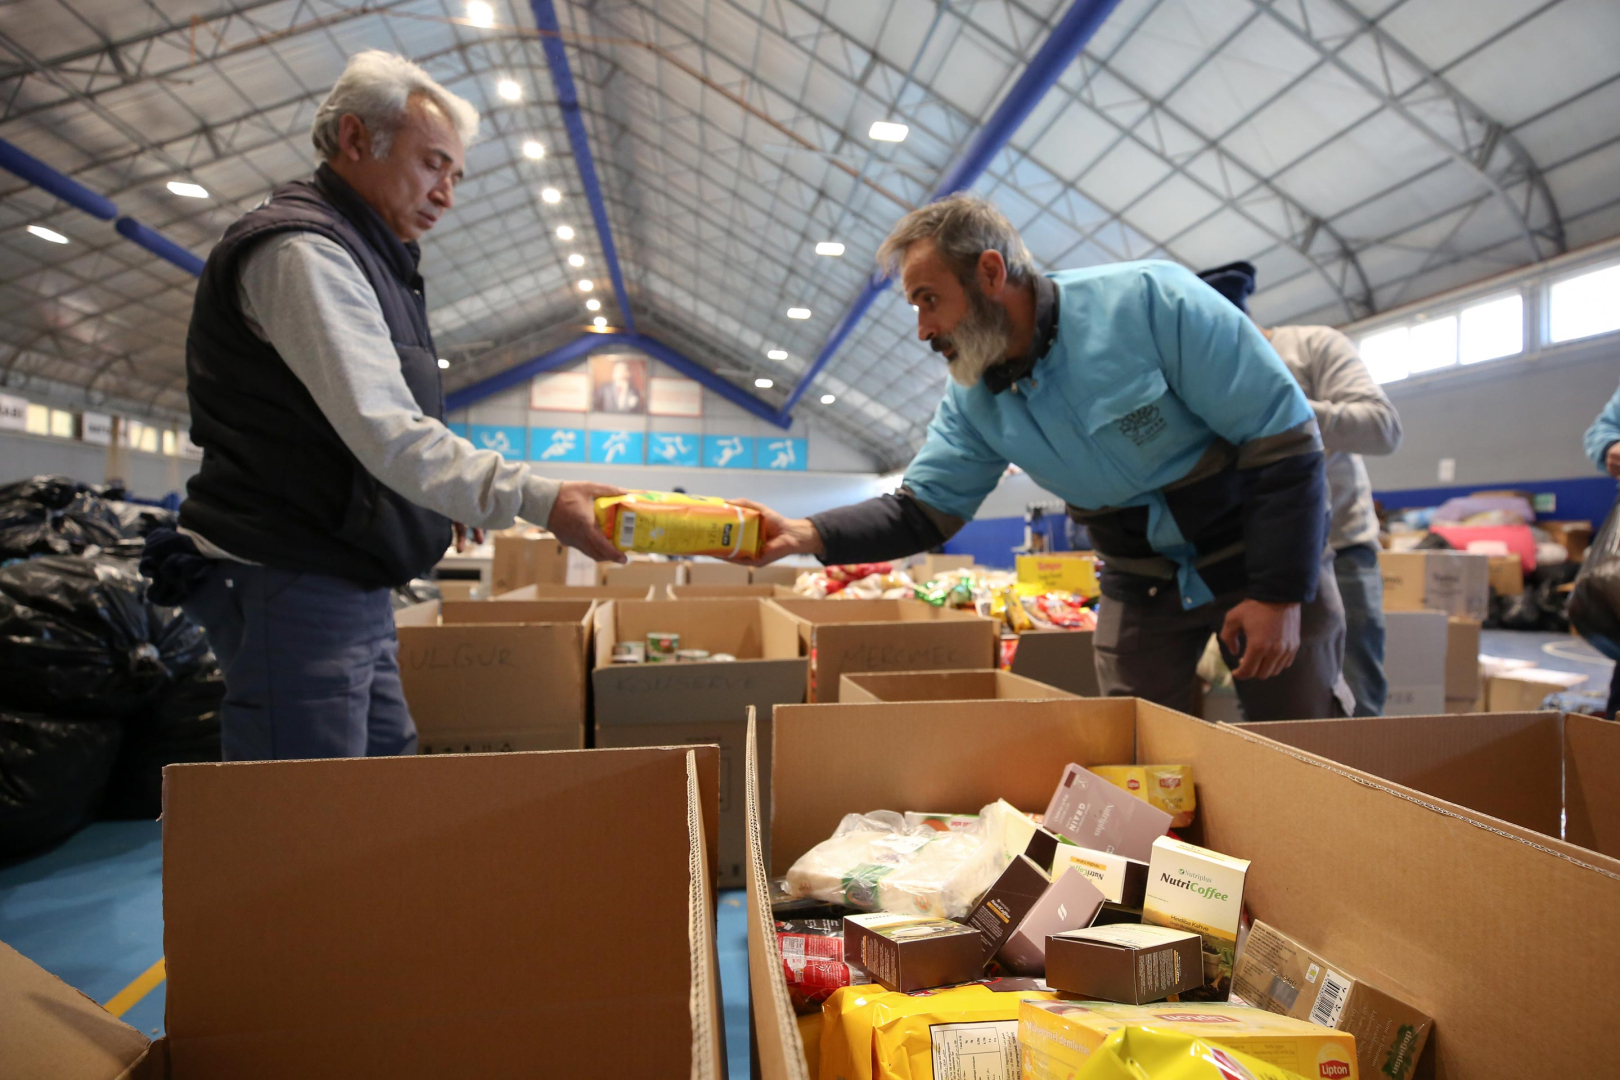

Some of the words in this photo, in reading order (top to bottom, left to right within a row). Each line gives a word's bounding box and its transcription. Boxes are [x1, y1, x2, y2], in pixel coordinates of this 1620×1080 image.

[1068, 802, 1086, 832] GRAIN
[1184, 870, 1212, 883] Nutriplus
[1160, 872, 1229, 901] NutriCoffee
[1170, 915, 1191, 926] Hindiba
[1191, 920, 1209, 932] Kahve
[1321, 1064, 1348, 1078] Lipton
